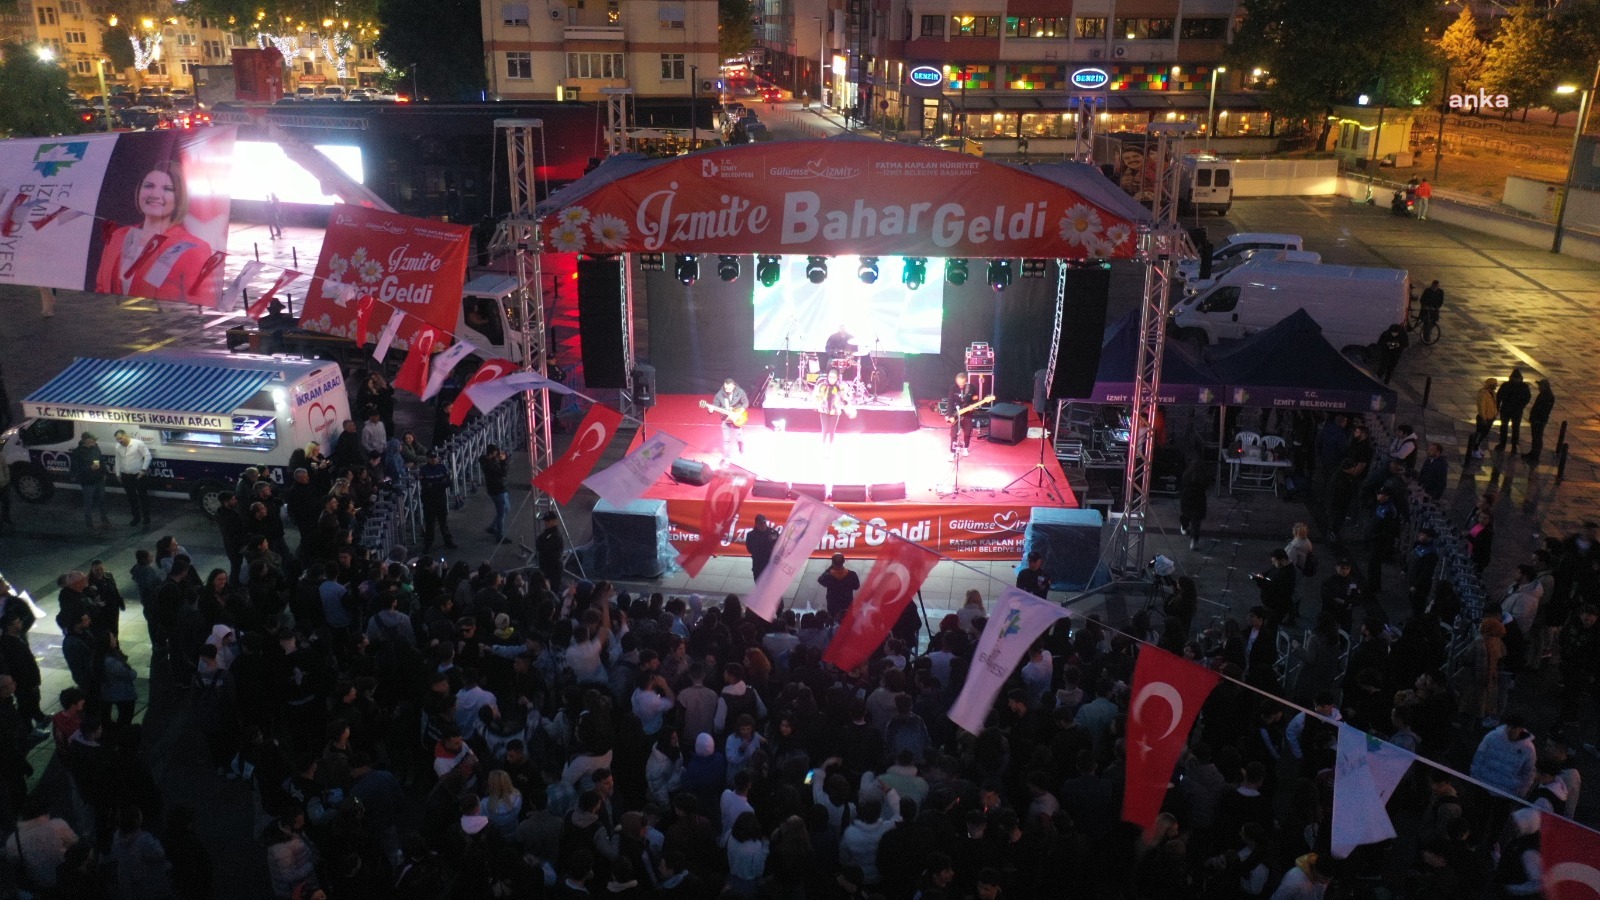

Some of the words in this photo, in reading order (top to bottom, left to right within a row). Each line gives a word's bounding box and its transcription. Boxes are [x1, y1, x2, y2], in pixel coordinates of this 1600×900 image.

[914, 72, 939, 81] BENZİN
[1075, 73, 1104, 83] BENZİN
[875, 161, 903, 170] FATMA
[905, 161, 937, 170] KAPLAN
[939, 160, 980, 170] HÜRRİYET
[720, 171, 754, 179] BELEDİYESİ
[770, 167, 809, 177] Gülümse
[825, 167, 853, 177] İZMİT
[940, 169, 972, 177] BAŞKANI
[636, 181, 771, 250] İzmit'e
[780, 190, 932, 245] Bahar
[931, 201, 1048, 248] Geldi
[388, 243, 442, 273] İzmit'e
[379, 275, 434, 304] Geldi
[295, 386, 323, 407] İKRAM
[323, 375, 342, 395] ARACI
[1106, 394, 1128, 402] İZMİT
[1273, 399, 1296, 407] İZMİT
[1299, 400, 1347, 409] BELEDİYESİ
[36, 406, 54, 417] T.C.
[56, 407, 86, 419] İZMİT
[88, 410, 147, 423] BELEDİYESİ
[148, 414, 185, 426] İKRAM
[188, 417, 222, 428] ARACI
[949, 519, 996, 530] Gülümse
